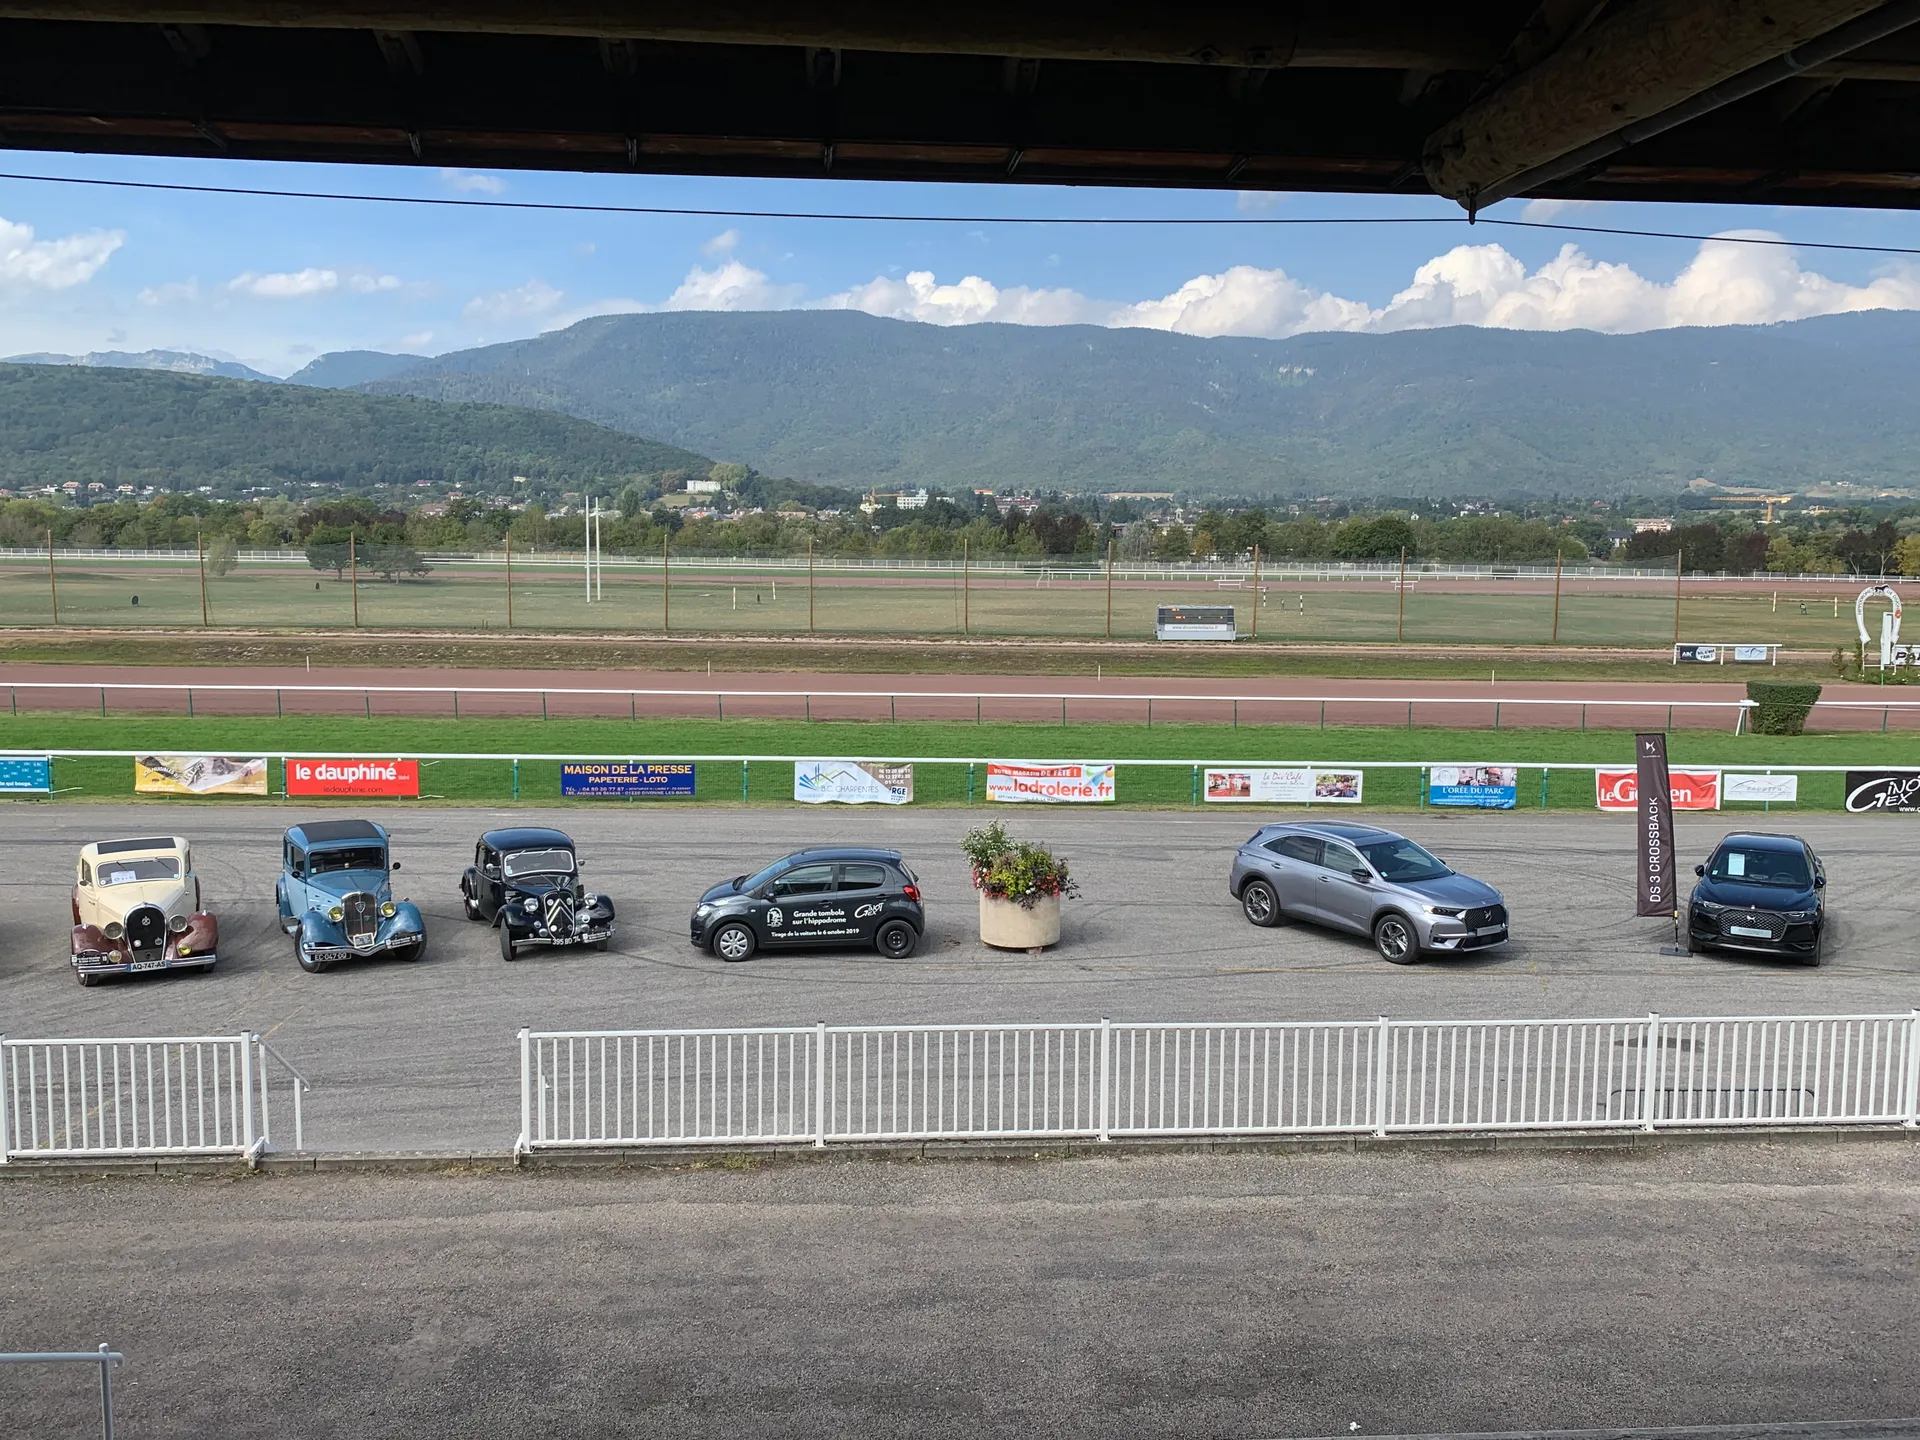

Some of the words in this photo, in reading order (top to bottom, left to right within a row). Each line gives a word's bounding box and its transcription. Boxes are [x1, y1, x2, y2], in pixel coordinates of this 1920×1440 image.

[295, 763, 312, 780] le
[314, 762, 397, 784] dauphiné
[564, 765, 609, 774] MAISON
[611, 765, 627, 774] DE
[629, 765, 645, 774] LA
[647, 765, 692, 774] PRESSE
[588, 776, 638, 784] PAPETERIE
[643, 776, 668, 784] LOTO
[835, 784, 879, 794] CHARPENTES
[892, 788, 907, 796] RGE
[989, 778, 1112, 797] www.ladrolerie.fr
[1442, 786, 1468, 794] L'ORÉE
[1484, 787, 1504, 795] PARC
[1649, 796, 1661, 872] CROSSBACK
[1650, 874, 1661, 883] 3
[1650, 885, 1661, 902] DS
[793, 910, 817, 918] Grande
[804, 917, 846, 926] l'hippodrome
[132, 961, 166, 970] AQ-747-AS
